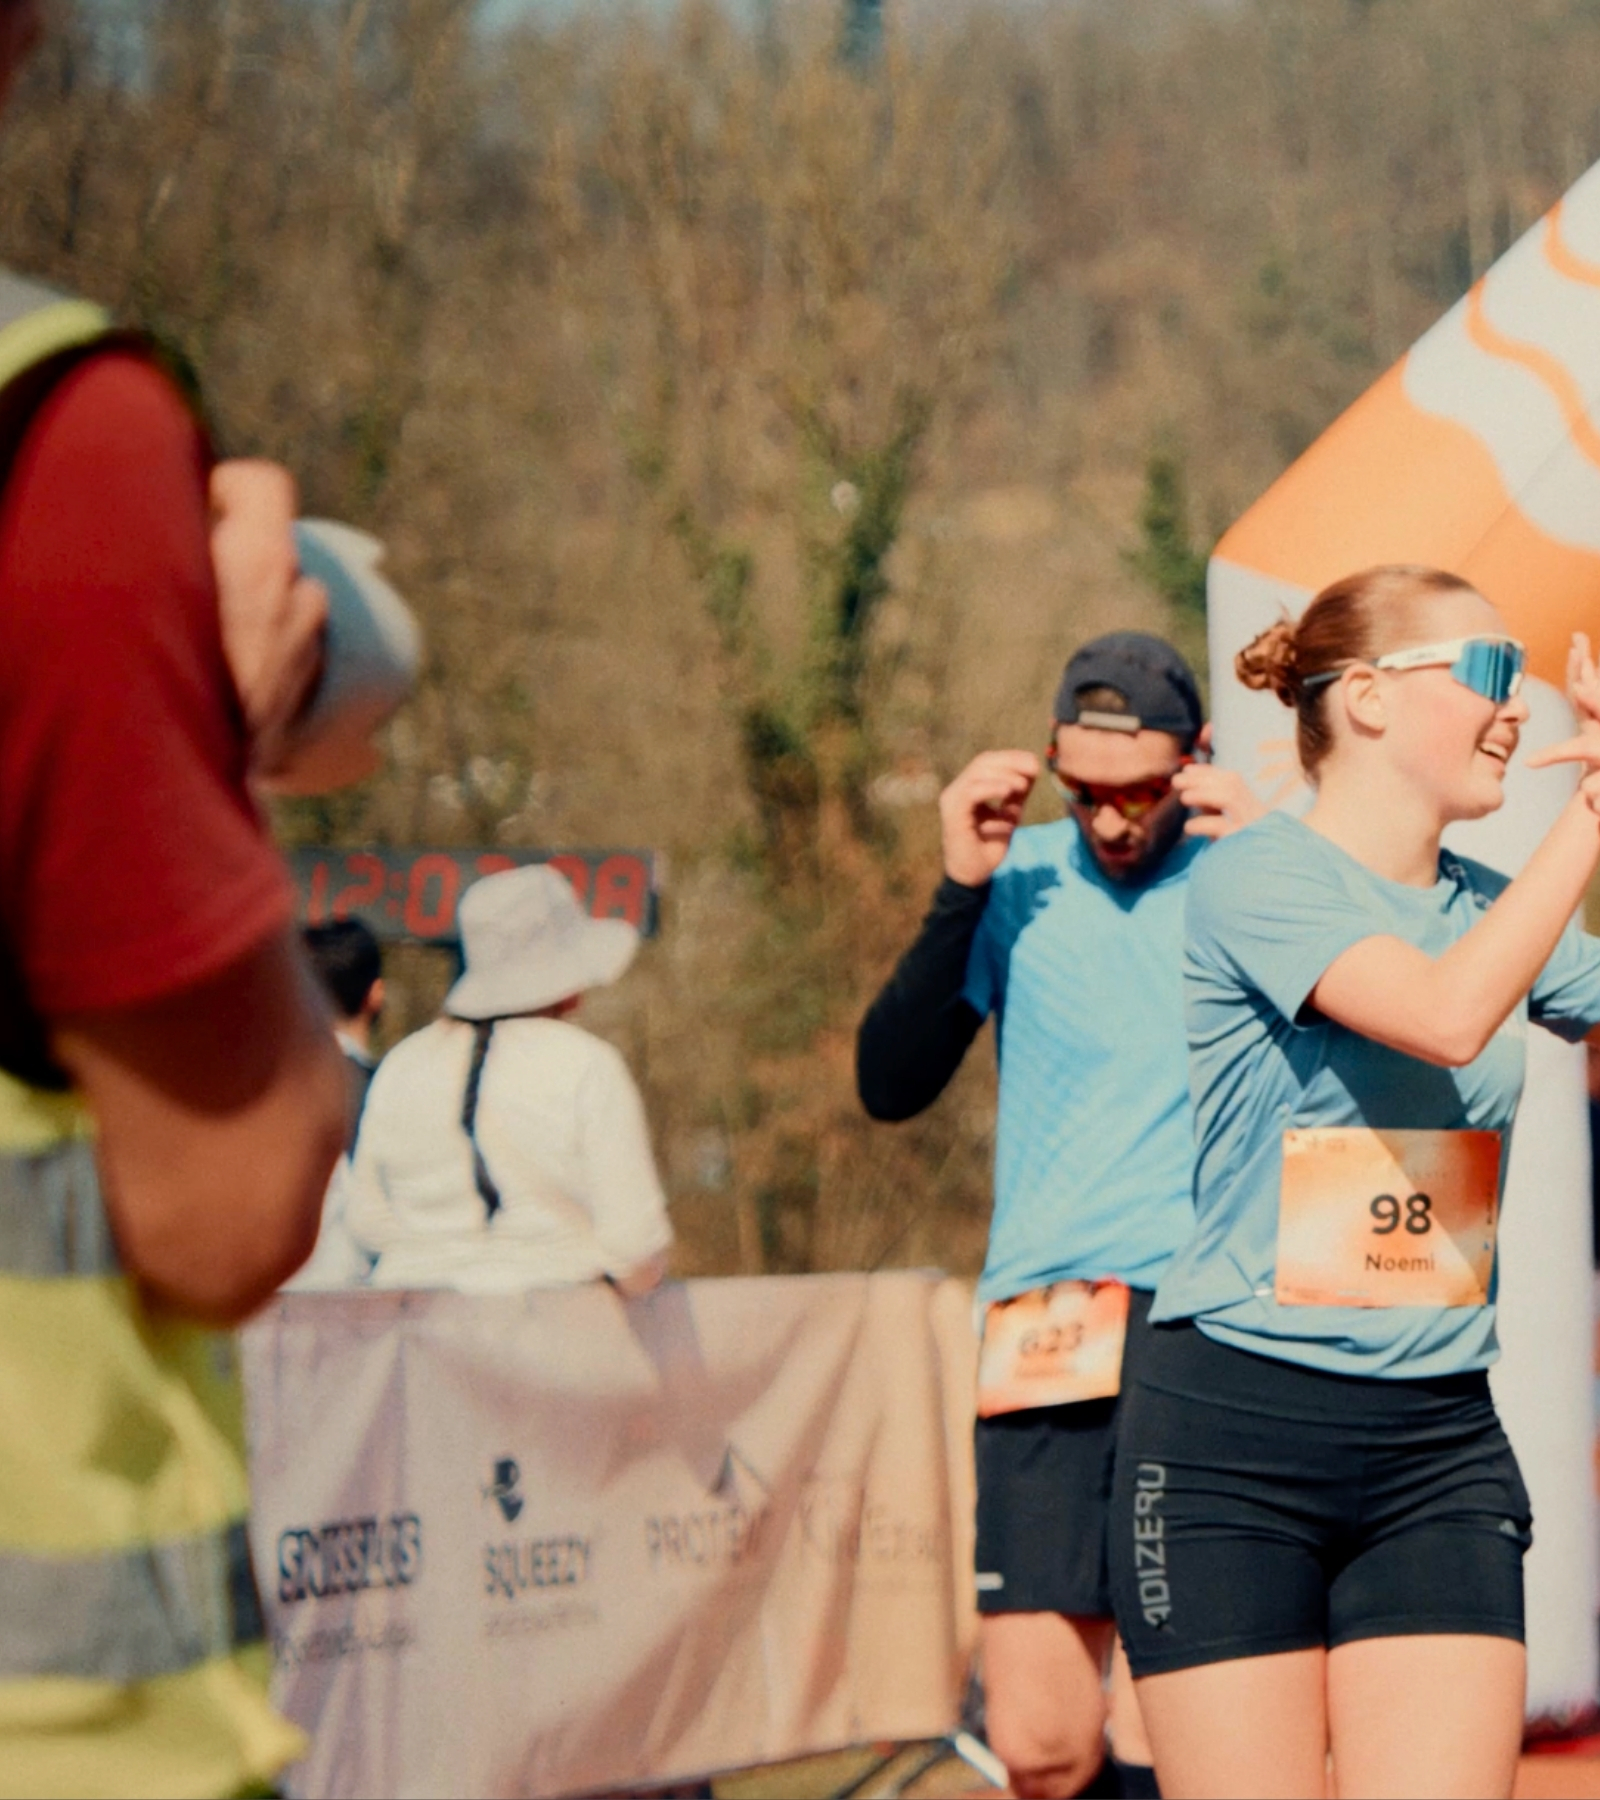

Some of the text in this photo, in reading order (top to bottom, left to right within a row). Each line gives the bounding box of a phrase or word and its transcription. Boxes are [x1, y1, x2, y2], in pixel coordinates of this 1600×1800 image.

[1369, 1192, 1433, 1236] 98
[1364, 1252, 1435, 1273] Noemi
[484, 1535, 592, 1600] SQUEEZY
